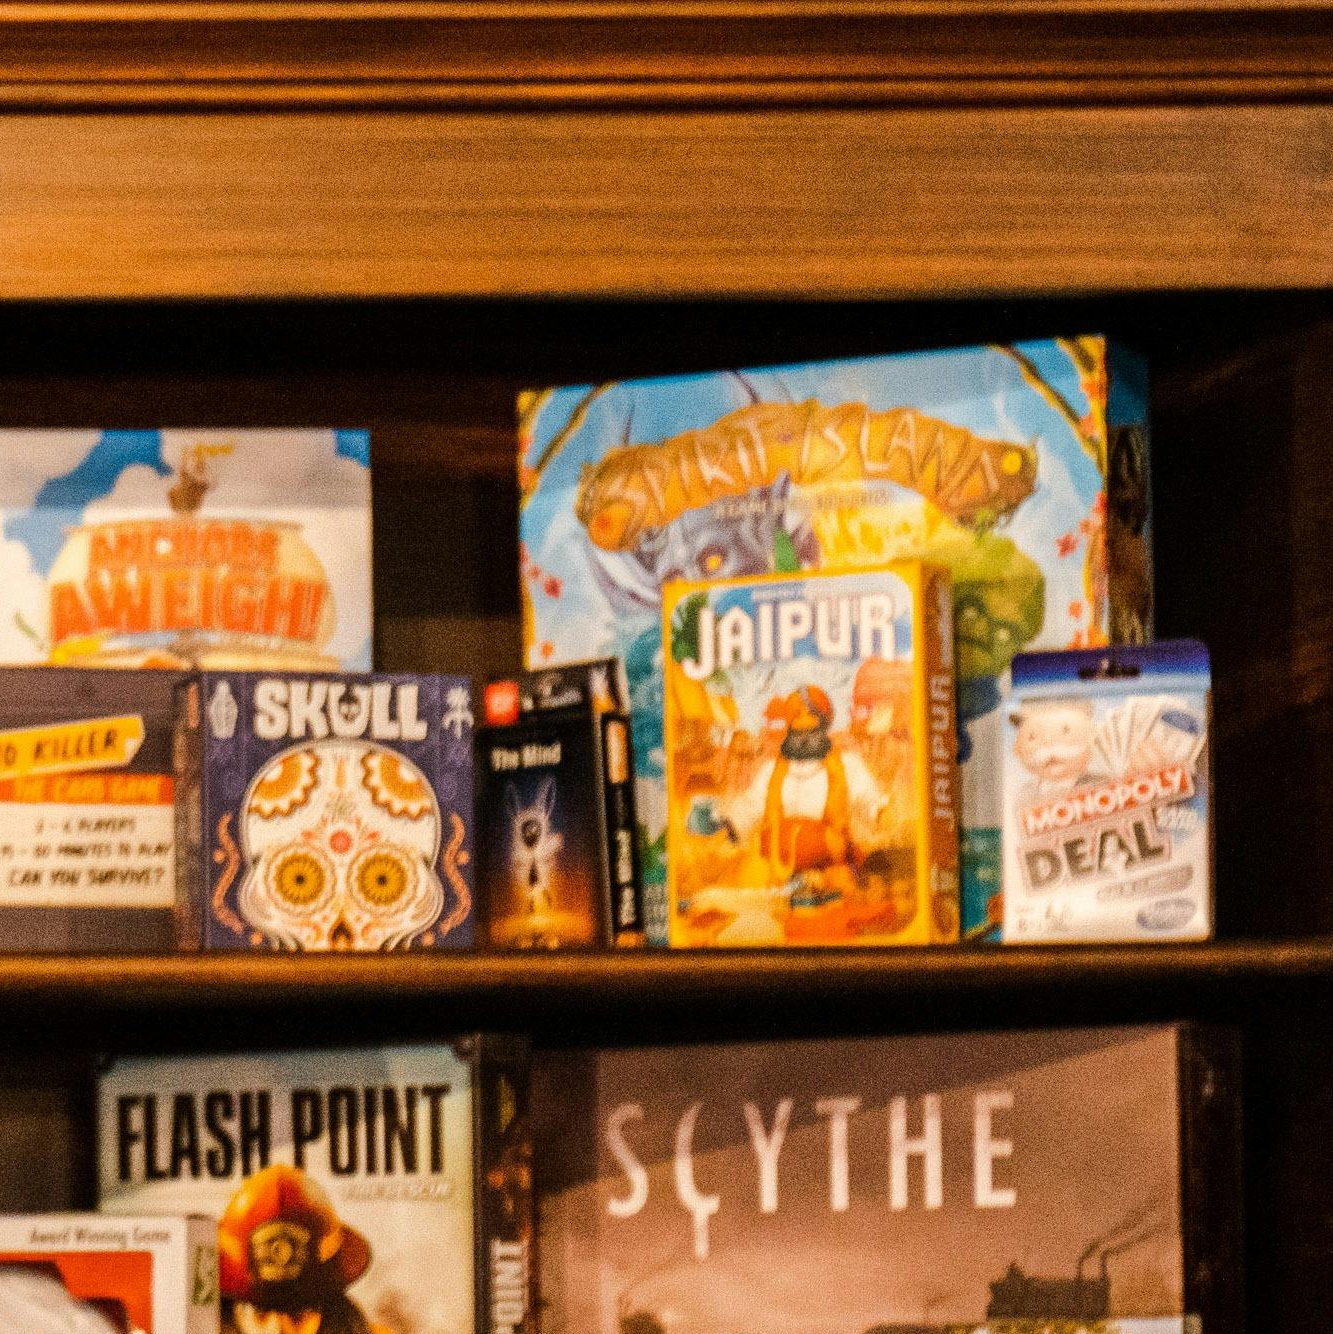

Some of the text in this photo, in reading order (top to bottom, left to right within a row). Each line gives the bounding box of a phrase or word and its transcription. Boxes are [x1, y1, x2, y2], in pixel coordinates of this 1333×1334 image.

[681, 593, 897, 680] JAIPUR
[34, 727, 120, 760] KILLER
[254, 680, 427, 741] SKULL
[1025, 766, 1191, 834] MONOPOLY
[1023, 805, 1170, 890] DEAL
[118, 1084, 451, 1182] FLASH POINT
[607, 1090, 1017, 1258] SCYTHE
